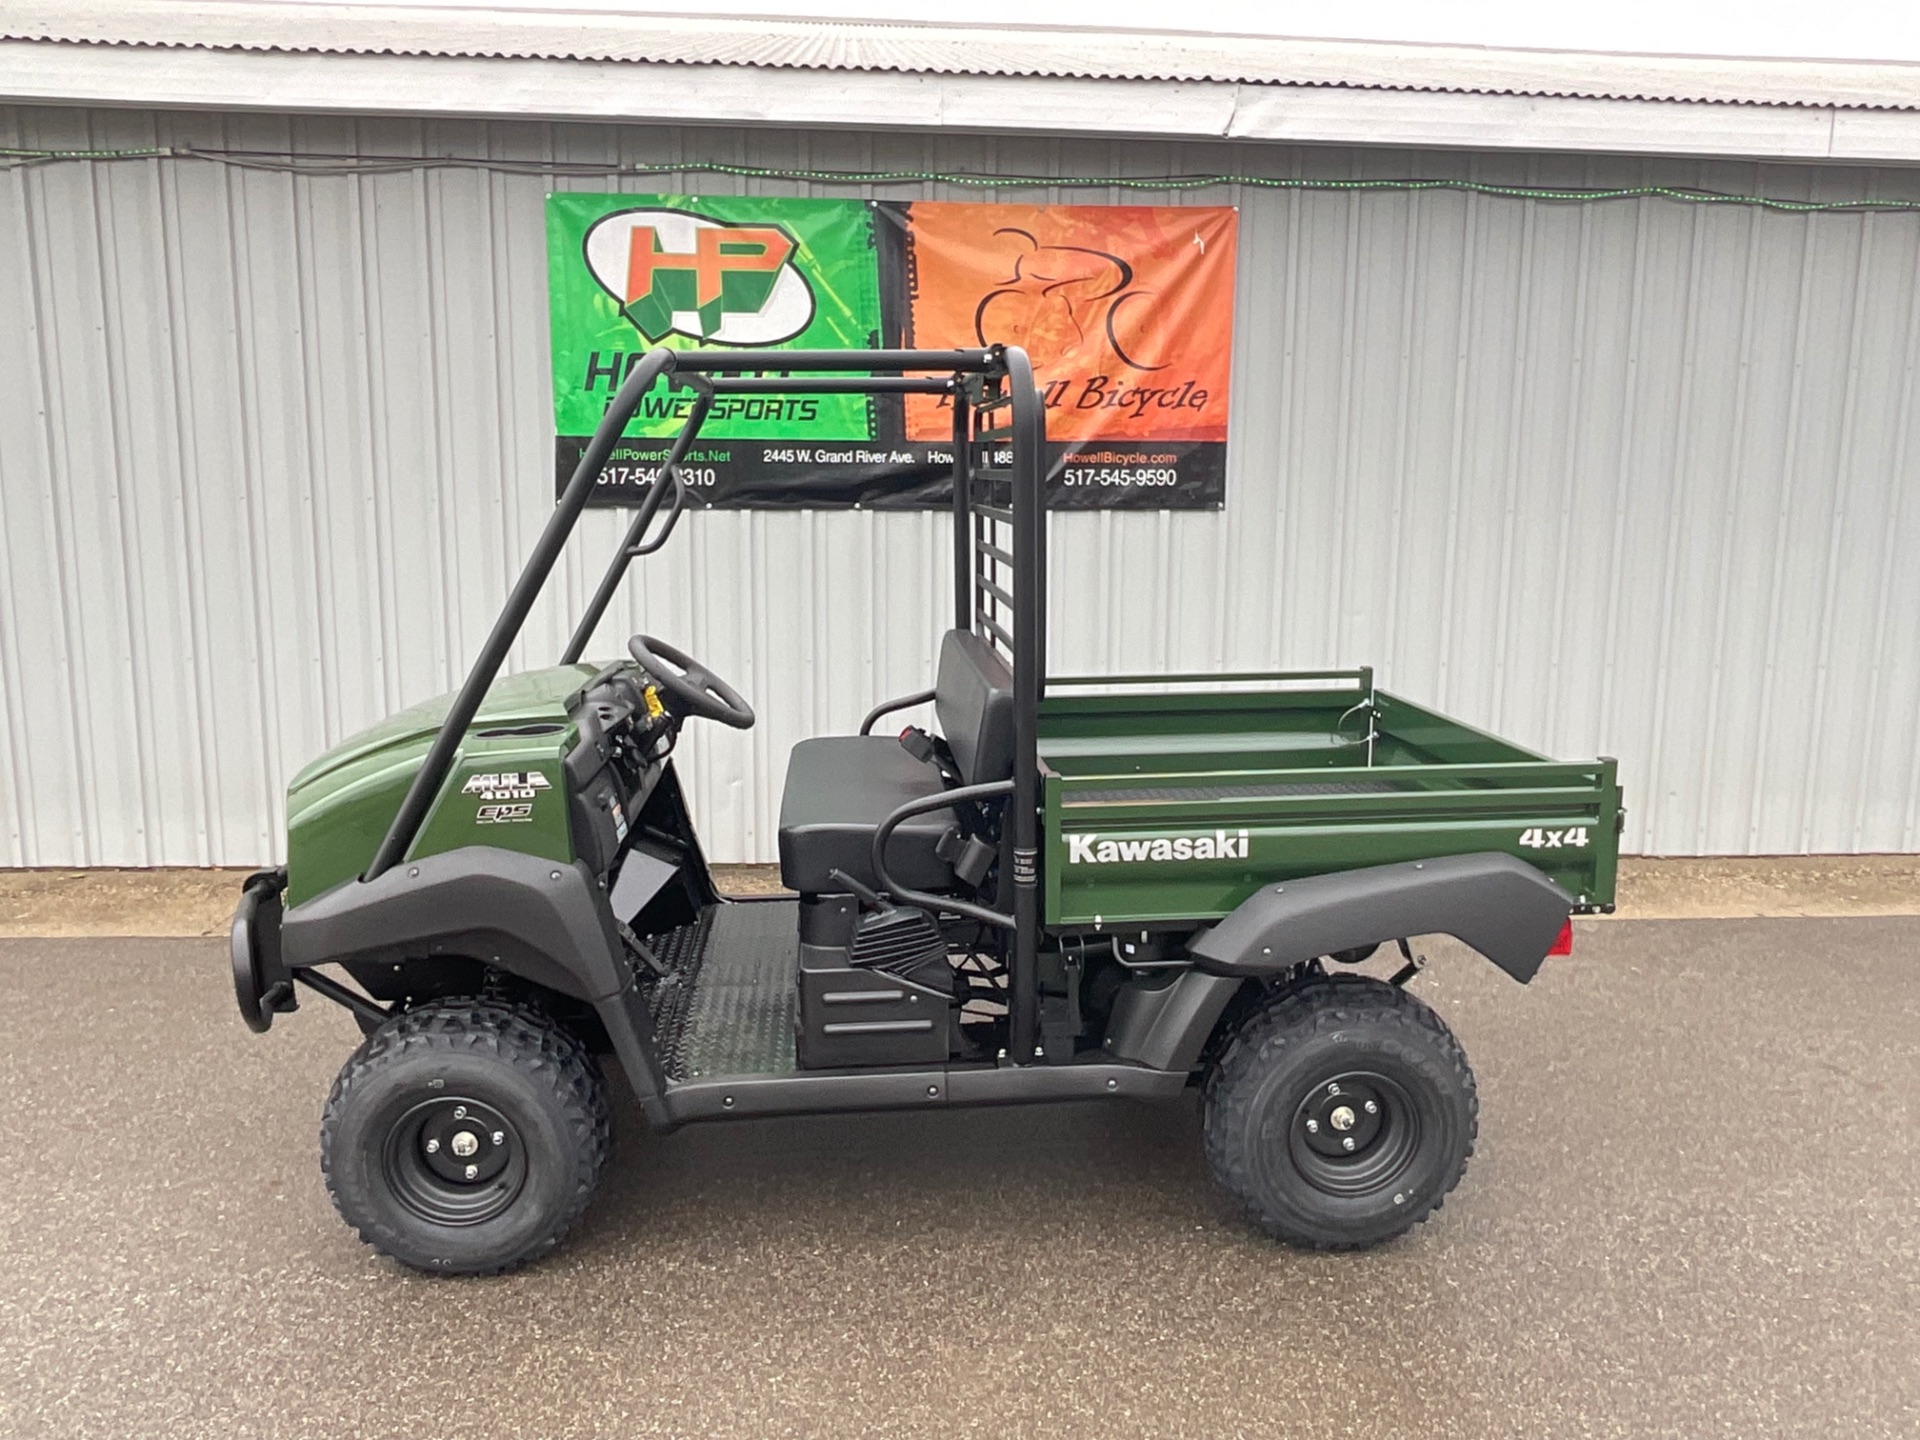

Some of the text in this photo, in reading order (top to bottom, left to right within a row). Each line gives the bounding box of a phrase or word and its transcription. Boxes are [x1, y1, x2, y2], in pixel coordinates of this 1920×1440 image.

[625, 225, 793, 312] HP
[1075, 375, 1209, 419] Bicycle
[763, 450, 795, 463] 2445
[796, 450, 812, 463] W.
[815, 450, 853, 463] Grand
[856, 450, 887, 463] River
[889, 450, 915, 463] Ave.
[1062, 452, 1177, 466] HowellBicycle.com
[1063, 468, 1177, 487] 517-545-9590
[461, 771, 552, 794] MULE
[480, 789, 536, 801] 4010
[1069, 829, 1249, 864] Kawasaki
[1519, 827, 1590, 849] 4x4
